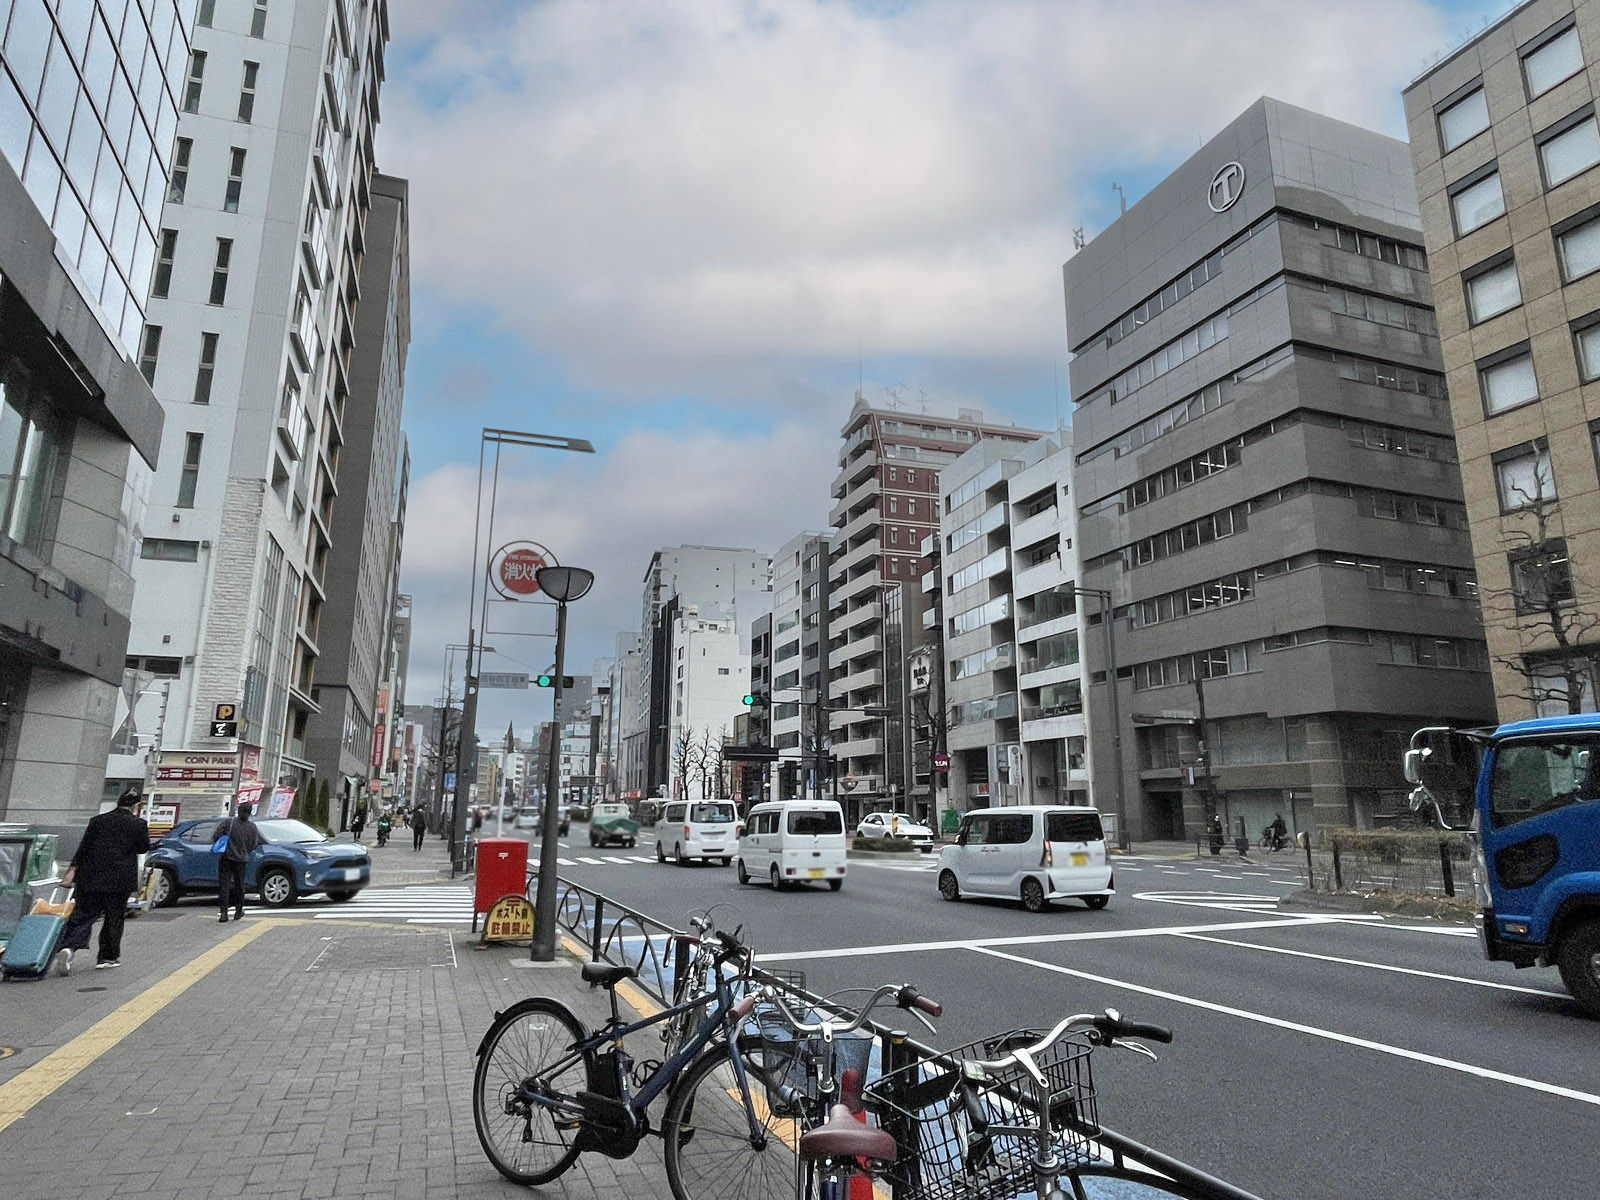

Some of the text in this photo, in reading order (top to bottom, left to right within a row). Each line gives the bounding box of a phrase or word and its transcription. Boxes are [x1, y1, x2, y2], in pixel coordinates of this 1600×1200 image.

[218, 705, 233, 719] P
[184, 756, 236, 765] COIN PARK
[491, 922, 531, 935] 駐輪禁止
